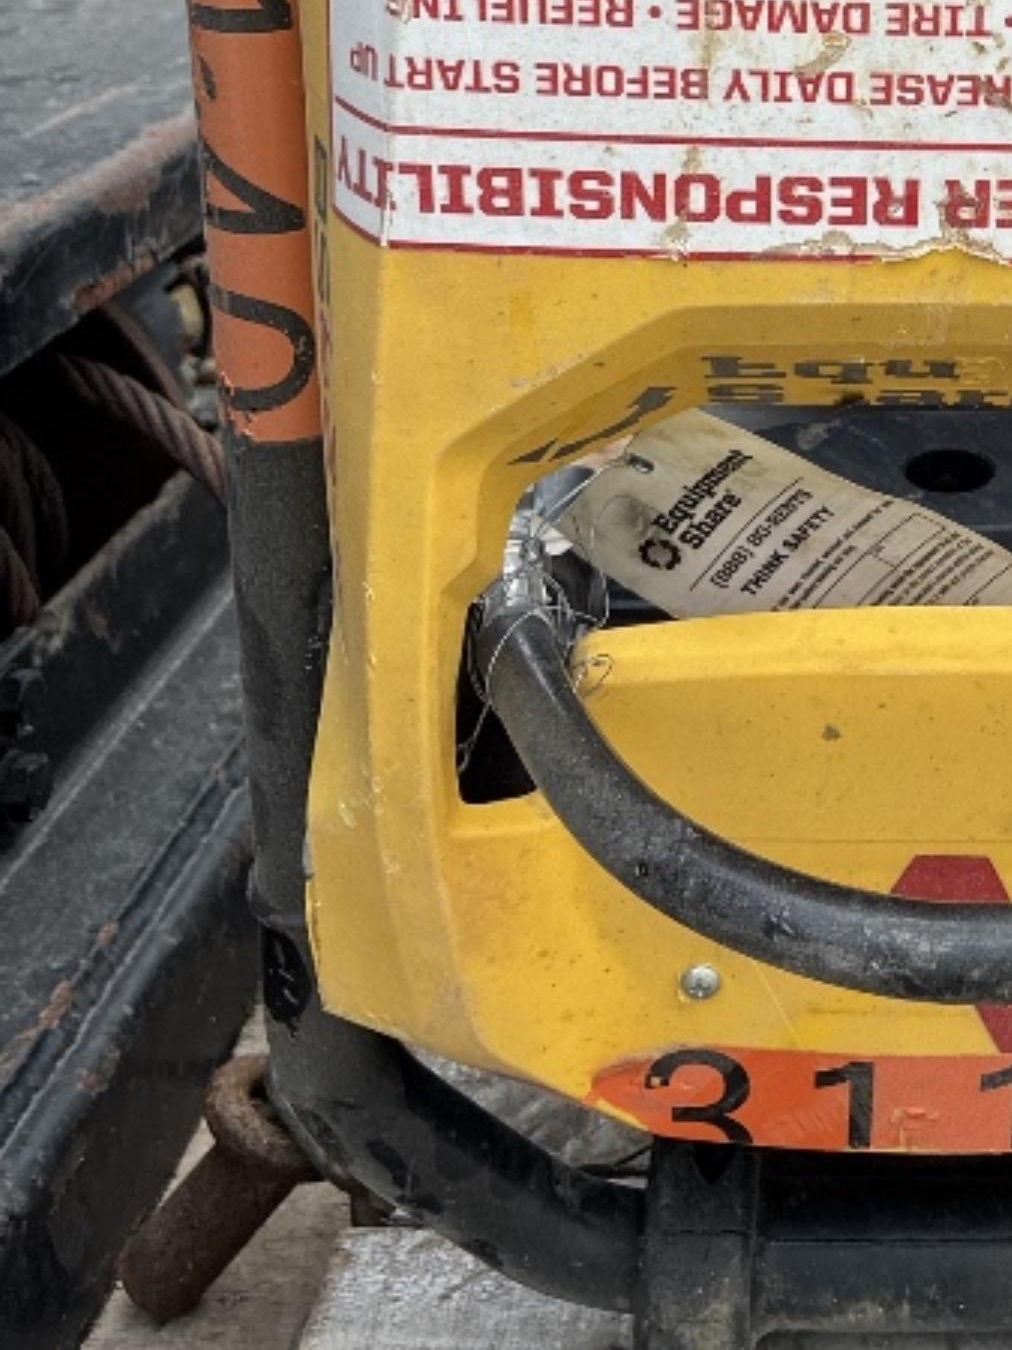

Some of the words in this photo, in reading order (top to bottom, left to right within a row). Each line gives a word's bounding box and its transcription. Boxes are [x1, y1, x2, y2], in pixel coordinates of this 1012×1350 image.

[887, 1, 991, 38] TIRE
[350, 43, 378, 76] UP
[384, 56, 519, 95] START
[537, 61, 708, 100] BEFORE
[724, 67, 853, 104] DAILY
[338, 136, 920, 227] RESPONSIBILITY
[652, 449, 754, 535] Equipment
[679, 489, 742, 549] Share
[740, 551, 790, 595] THINK
[782, 505, 836, 554] SAFETY
